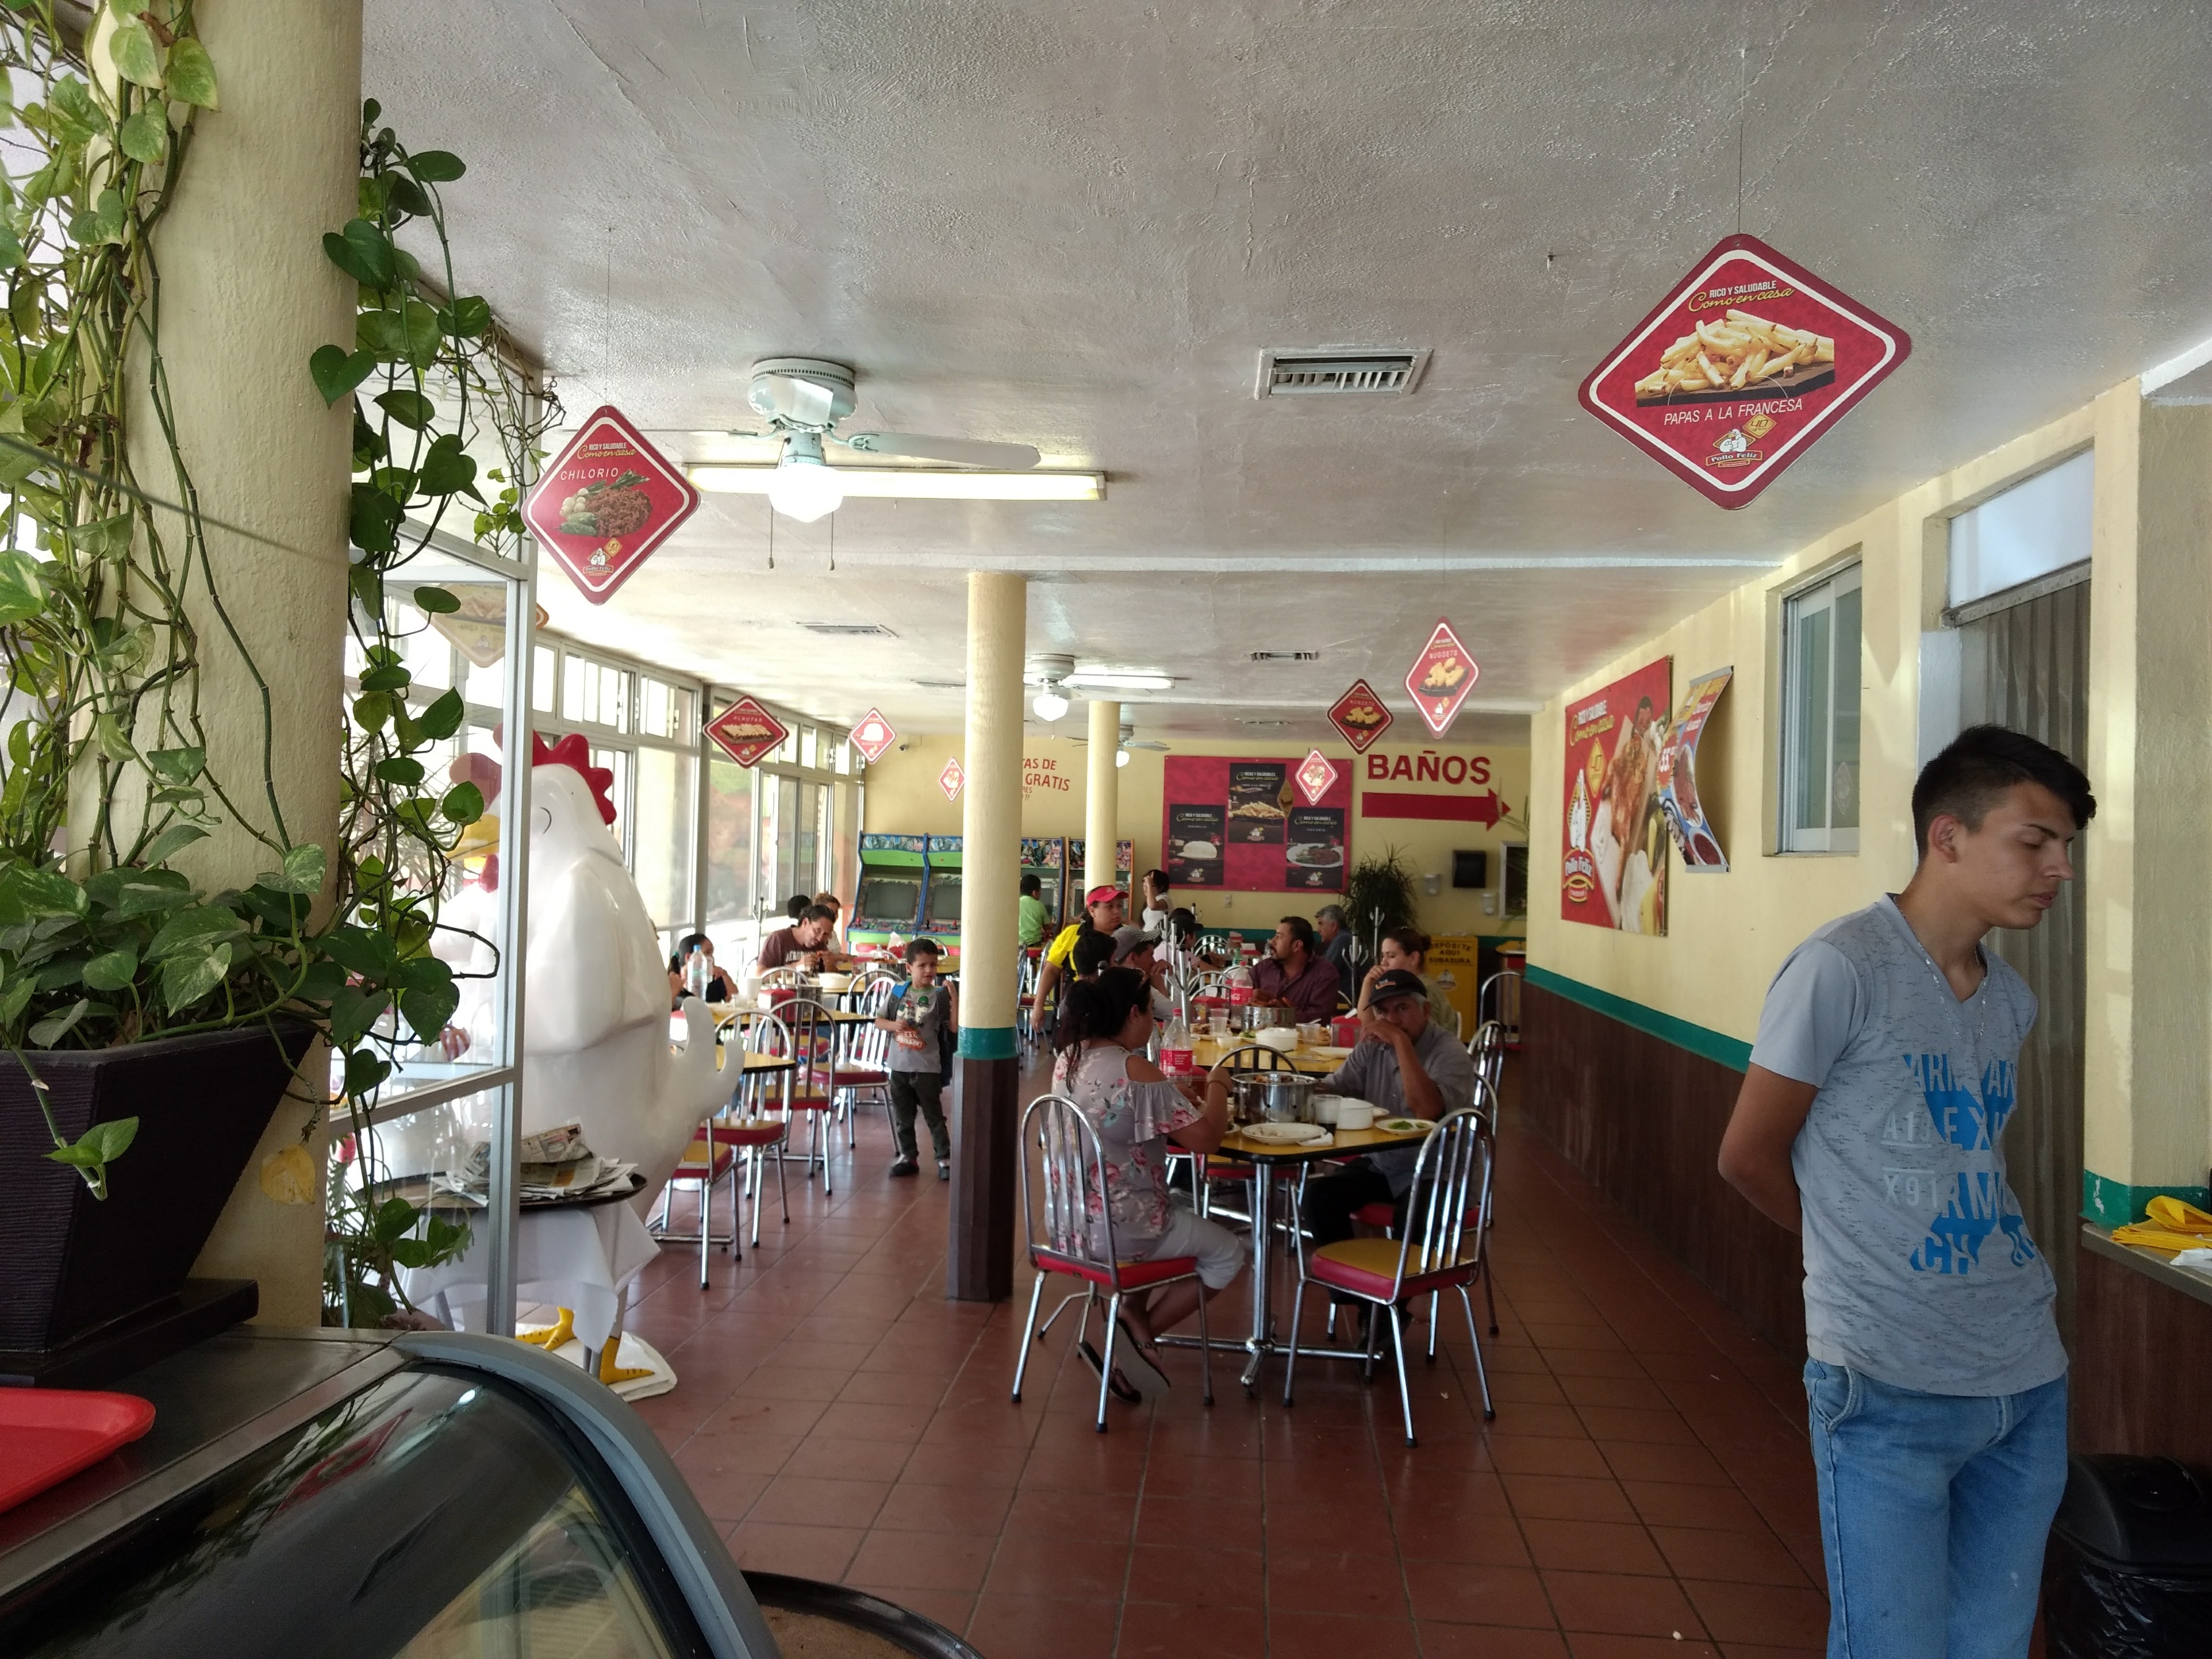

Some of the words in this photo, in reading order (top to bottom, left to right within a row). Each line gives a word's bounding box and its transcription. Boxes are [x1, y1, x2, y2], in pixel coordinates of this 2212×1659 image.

[1709, 288, 1726, 298] RICO
[1728, 287, 1733, 296] Y
[1734, 280, 1777, 294] SALUDABLE
[1688, 292, 1736, 312] Como
[1735, 295, 1757, 304] en
[1757, 288, 1795, 301] casa
[1664, 410, 1700, 426] PAPAS
[1705, 409, 1713, 421] A
[1718, 406, 1732, 420] LA
[1738, 398, 1803, 418] FRANCESA
[1750, 419, 1769, 428] 40
[577, 445, 603, 460] Como
[1711, 454, 1734, 462] Pollo
[561, 468, 619, 481] CHILORIO
[1430, 650, 1457, 659] NUGGETS
[1023, 758, 1039, 769] AS
[1042, 758, 1057, 770] DE
[1368, 750, 1491, 785] BAÑOS
[1025, 773, 1070, 792] GRATIS
[1565, 857, 1577, 877] Pollo
[1579, 856, 1592, 878] Feliz
